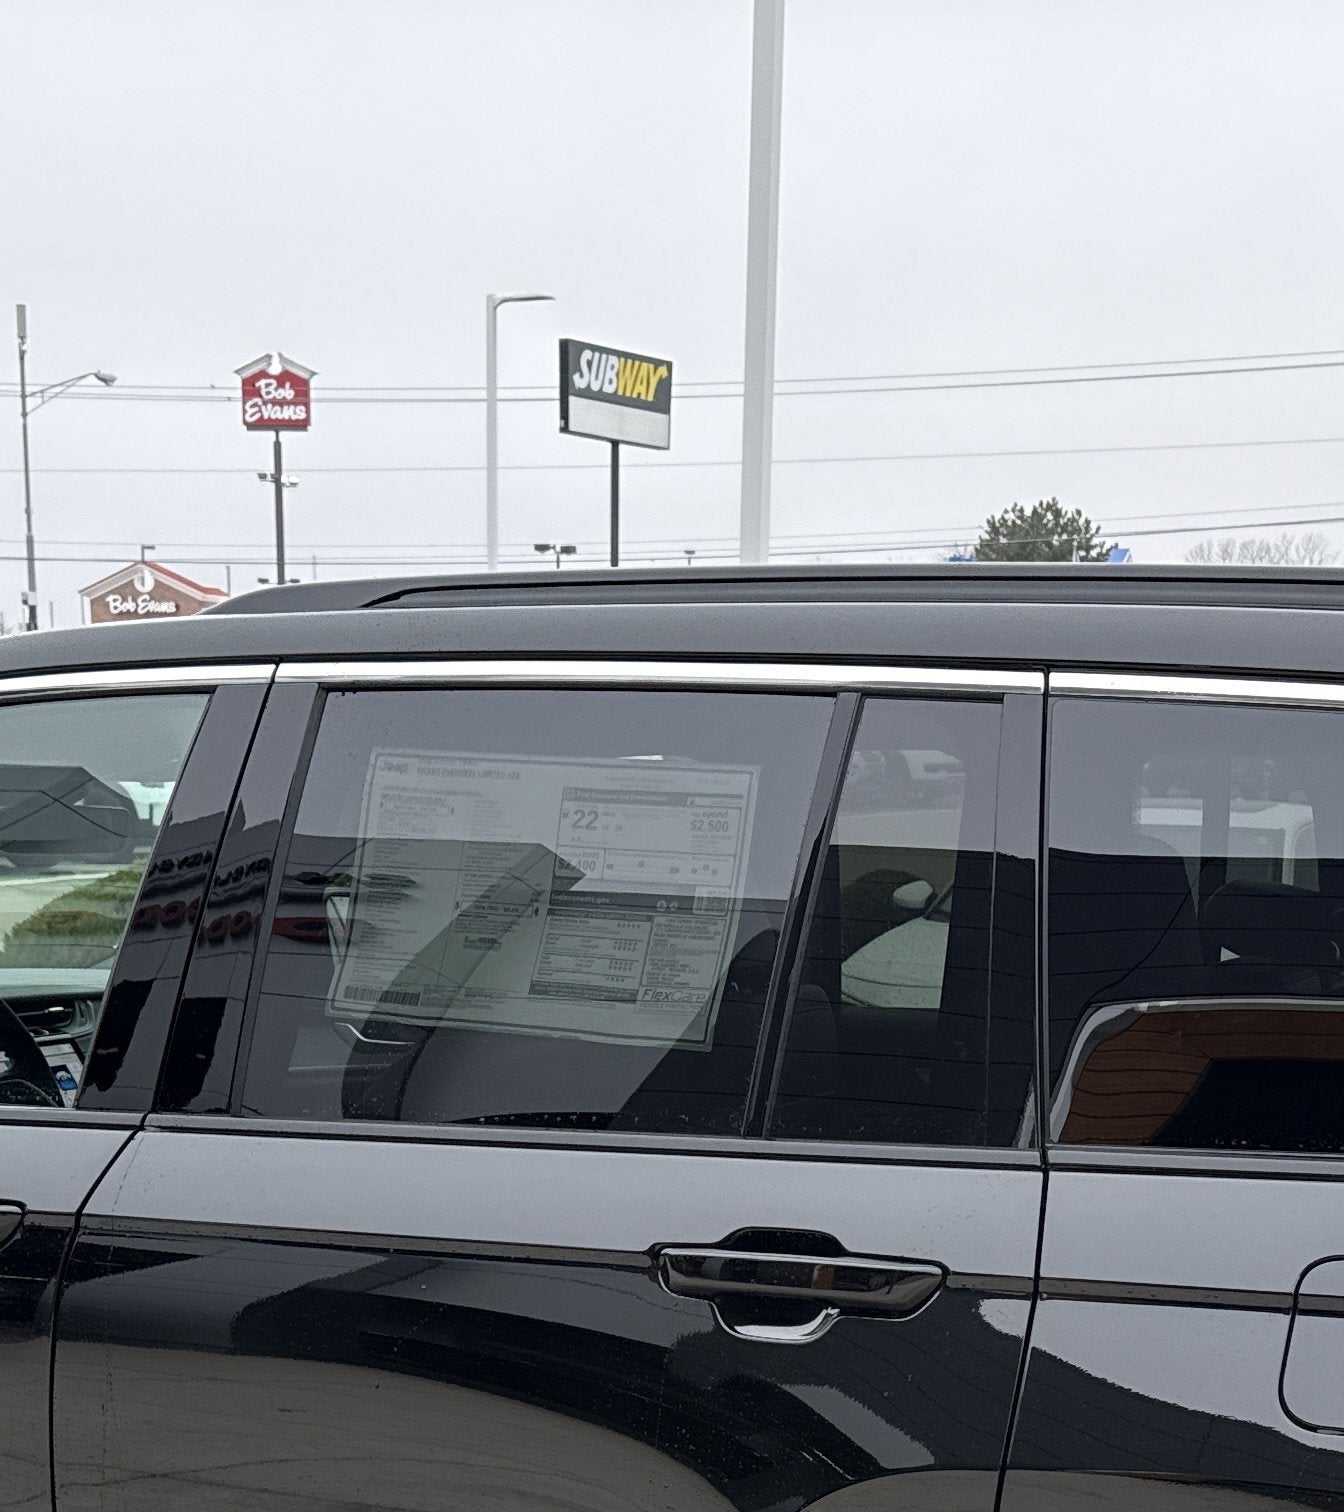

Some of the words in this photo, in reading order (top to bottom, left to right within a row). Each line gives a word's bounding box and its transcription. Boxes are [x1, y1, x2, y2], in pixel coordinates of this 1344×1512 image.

[573, 349, 668, 401] SUBWAY
[255, 379, 295, 399] Bob
[245, 398, 307, 422] Evans
[105, 594, 136, 614] Bob
[137, 594, 176, 614] Evans
[571, 809, 599, 831] 22
